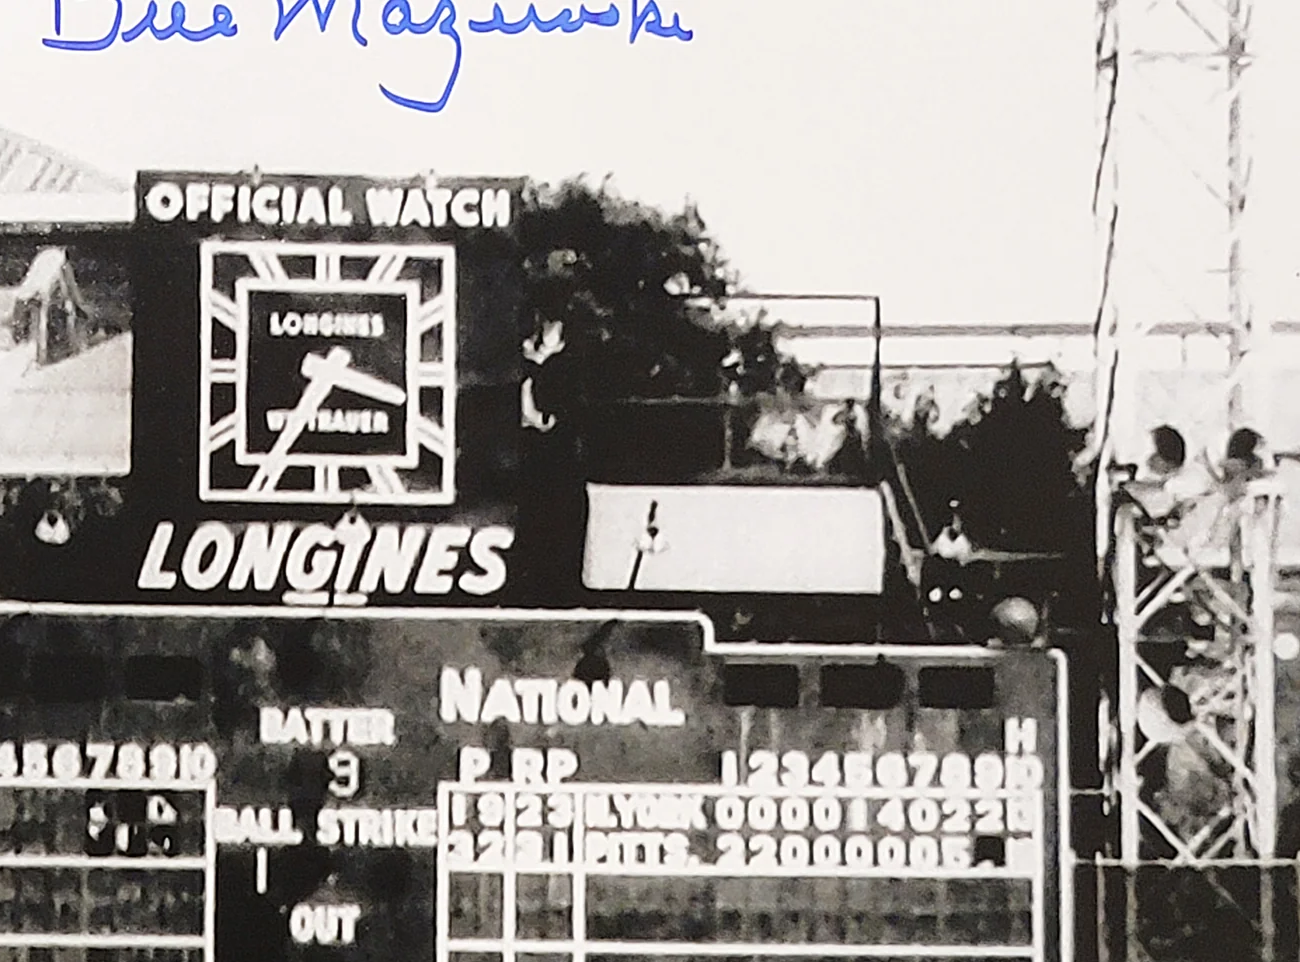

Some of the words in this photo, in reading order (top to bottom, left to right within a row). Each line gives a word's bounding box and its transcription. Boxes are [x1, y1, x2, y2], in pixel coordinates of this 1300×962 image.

[145, 181, 352, 226] OFFICIAL
[365, 186, 511, 228] WATCH
[137, 520, 516, 597] LONGINES
[439, 665, 687, 726] NATIONAL
[259, 705, 397, 746] BATTER
[327, 749, 361, 799] 9
[459, 745, 492, 783] P
[511, 746, 580, 784] RP
[214, 805, 304, 845] BALL
[316, 807, 438, 847] STRIKE
[289, 903, 362, 945] OUT
